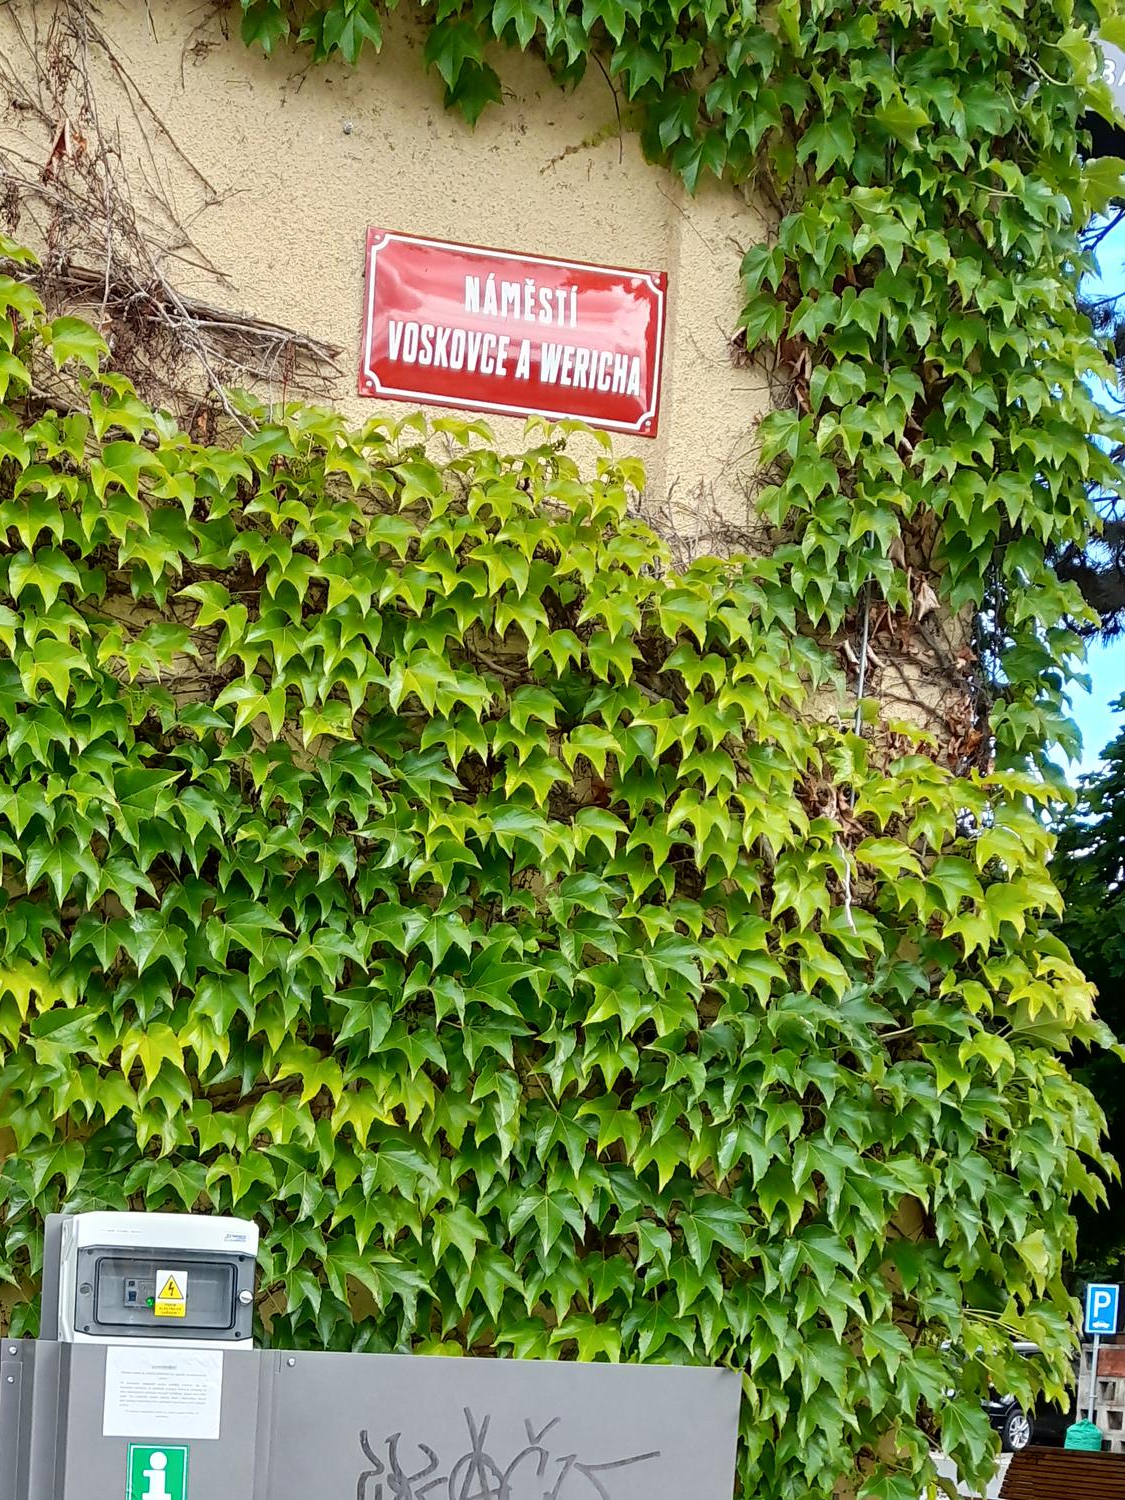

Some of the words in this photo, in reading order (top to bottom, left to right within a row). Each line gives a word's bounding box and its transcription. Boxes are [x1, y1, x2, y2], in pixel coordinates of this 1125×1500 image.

[464, 272, 578, 328] NÁMĚSTÍ
[388, 320, 511, 376] VOSKOVCE
[515, 338, 530, 380] A
[540, 343, 641, 396] WERICHA
[1094, 1291, 1111, 1318] P
